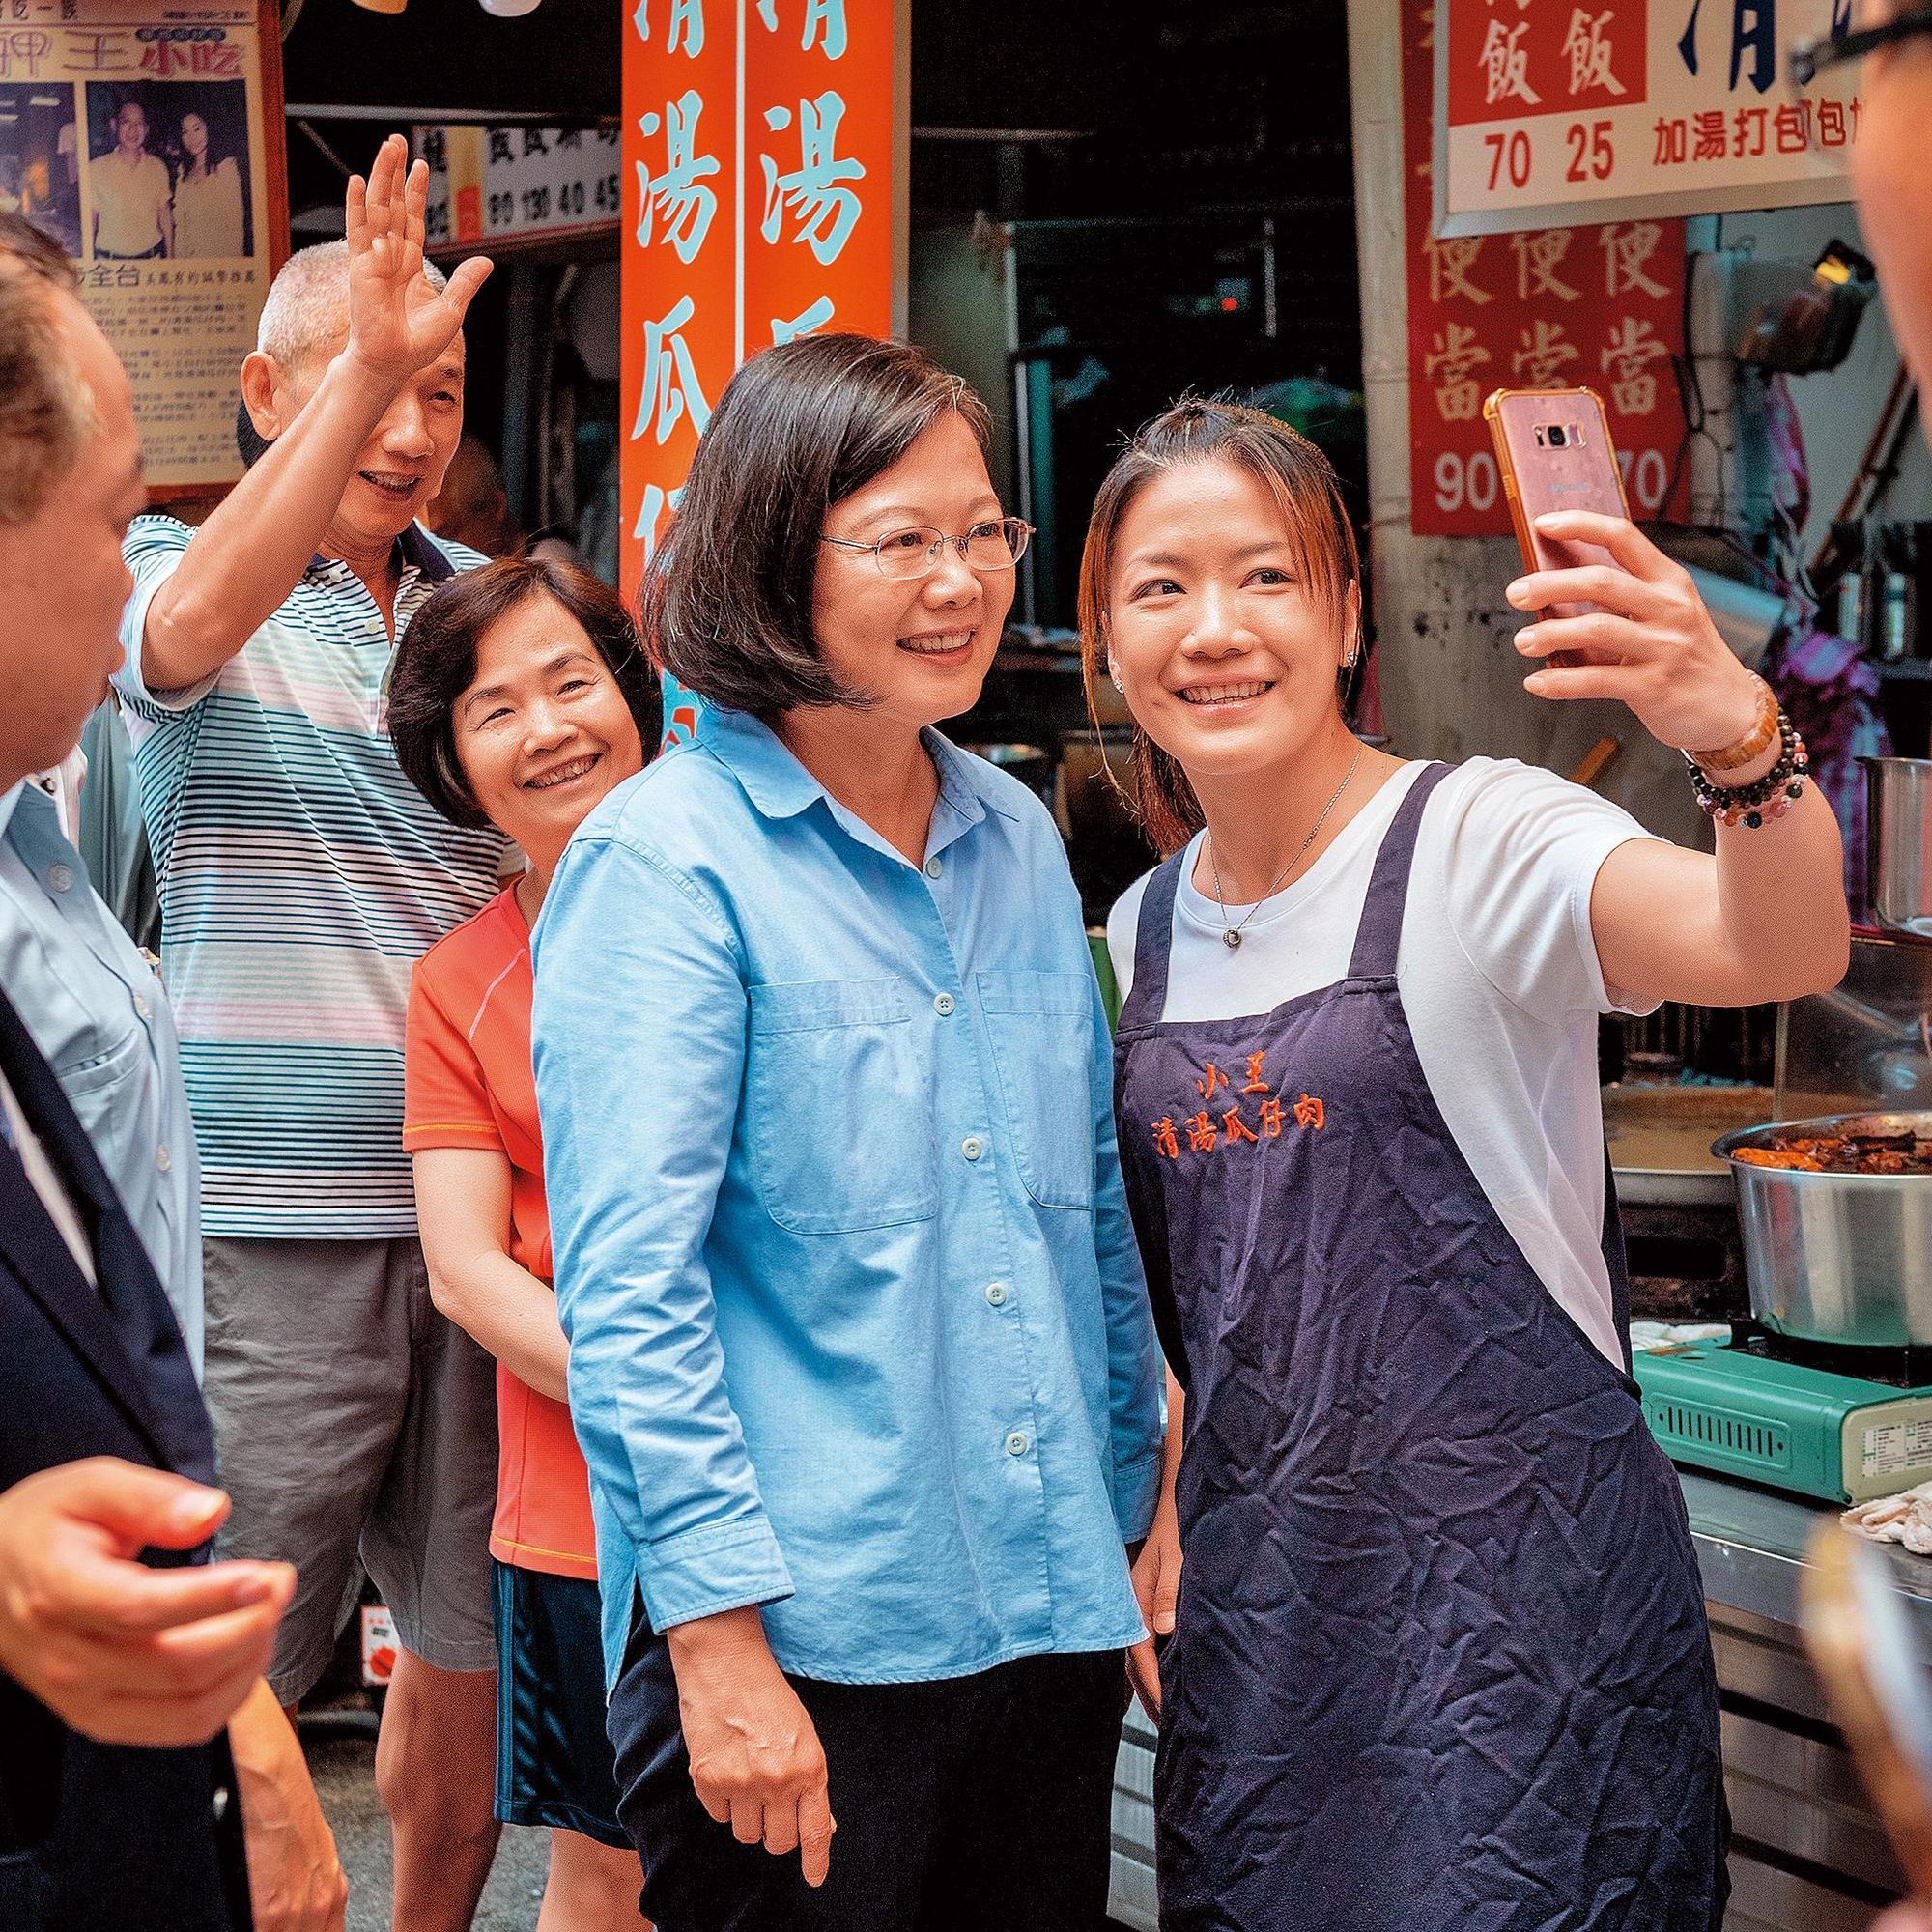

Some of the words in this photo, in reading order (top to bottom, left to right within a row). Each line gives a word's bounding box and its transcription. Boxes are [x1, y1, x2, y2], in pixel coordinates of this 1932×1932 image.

[1478, 0, 1543, 105] 飯
[1561, 0, 1628, 96] 飯
[1484, 130, 1531, 191] 70
[1566, 121, 1614, 182] 25
[77, 264, 141, 287] 全台
[1598, 221, 1671, 415] 便當
[1434, 451, 1497, 512] 90
